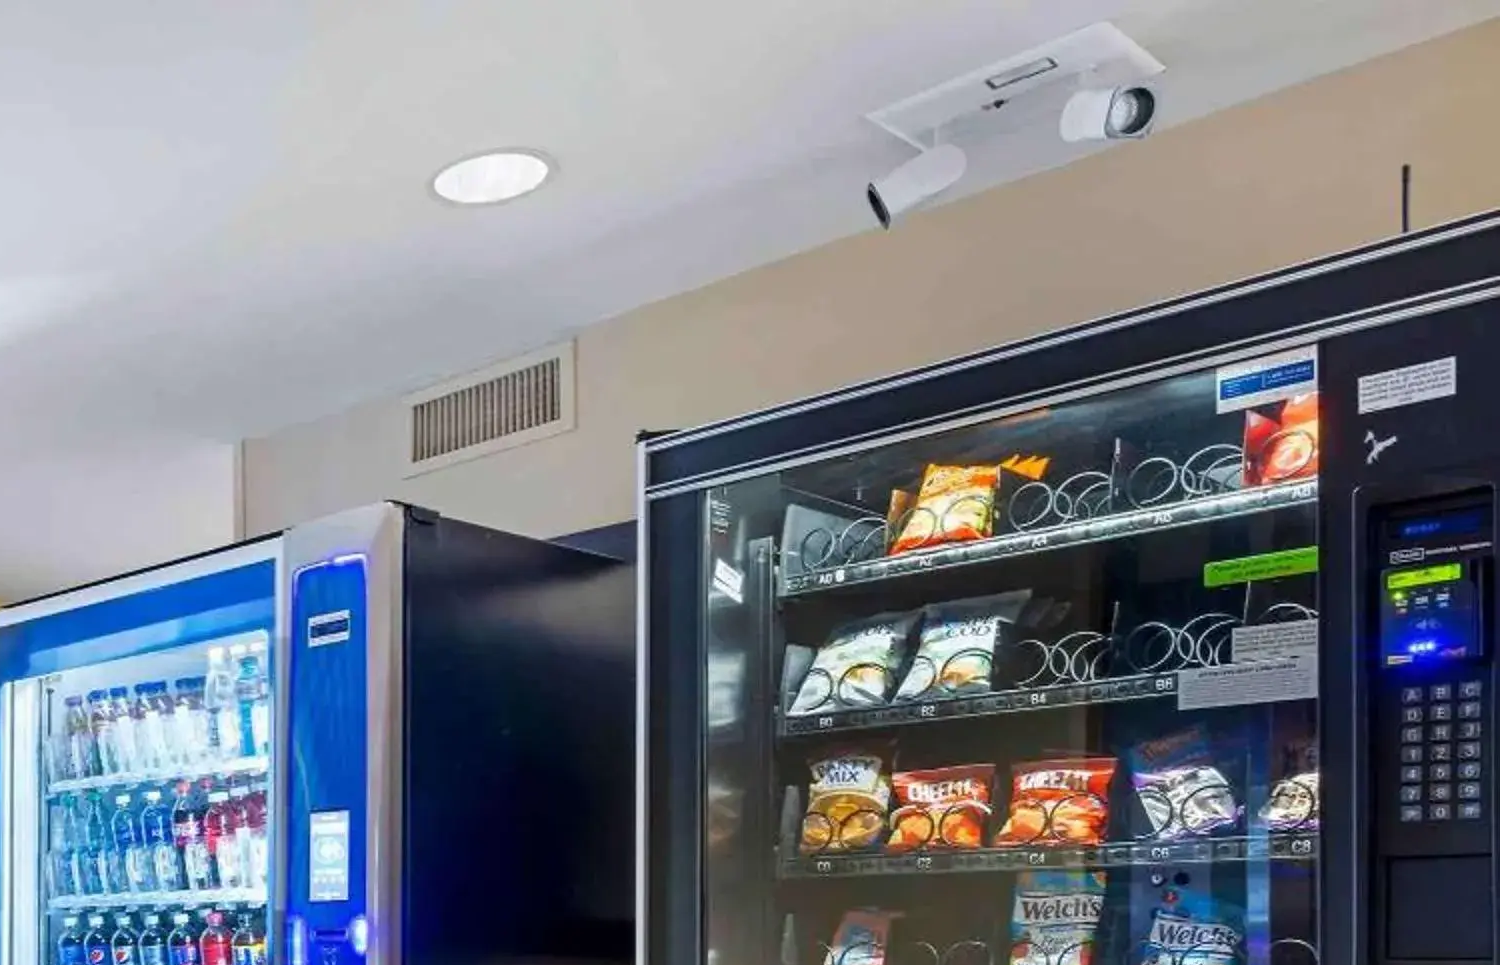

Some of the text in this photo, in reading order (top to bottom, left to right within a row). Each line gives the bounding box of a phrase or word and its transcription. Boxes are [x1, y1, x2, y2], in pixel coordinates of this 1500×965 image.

[1031, 693, 1048, 705] B4
[921, 705, 937, 717] B2
[826, 771, 859, 784] MIX
[1152, 847, 1170, 860] C6
[1291, 840, 1312, 854] C8
[1029, 852, 1046, 865] C4
[1023, 898, 1100, 919] Welch's
